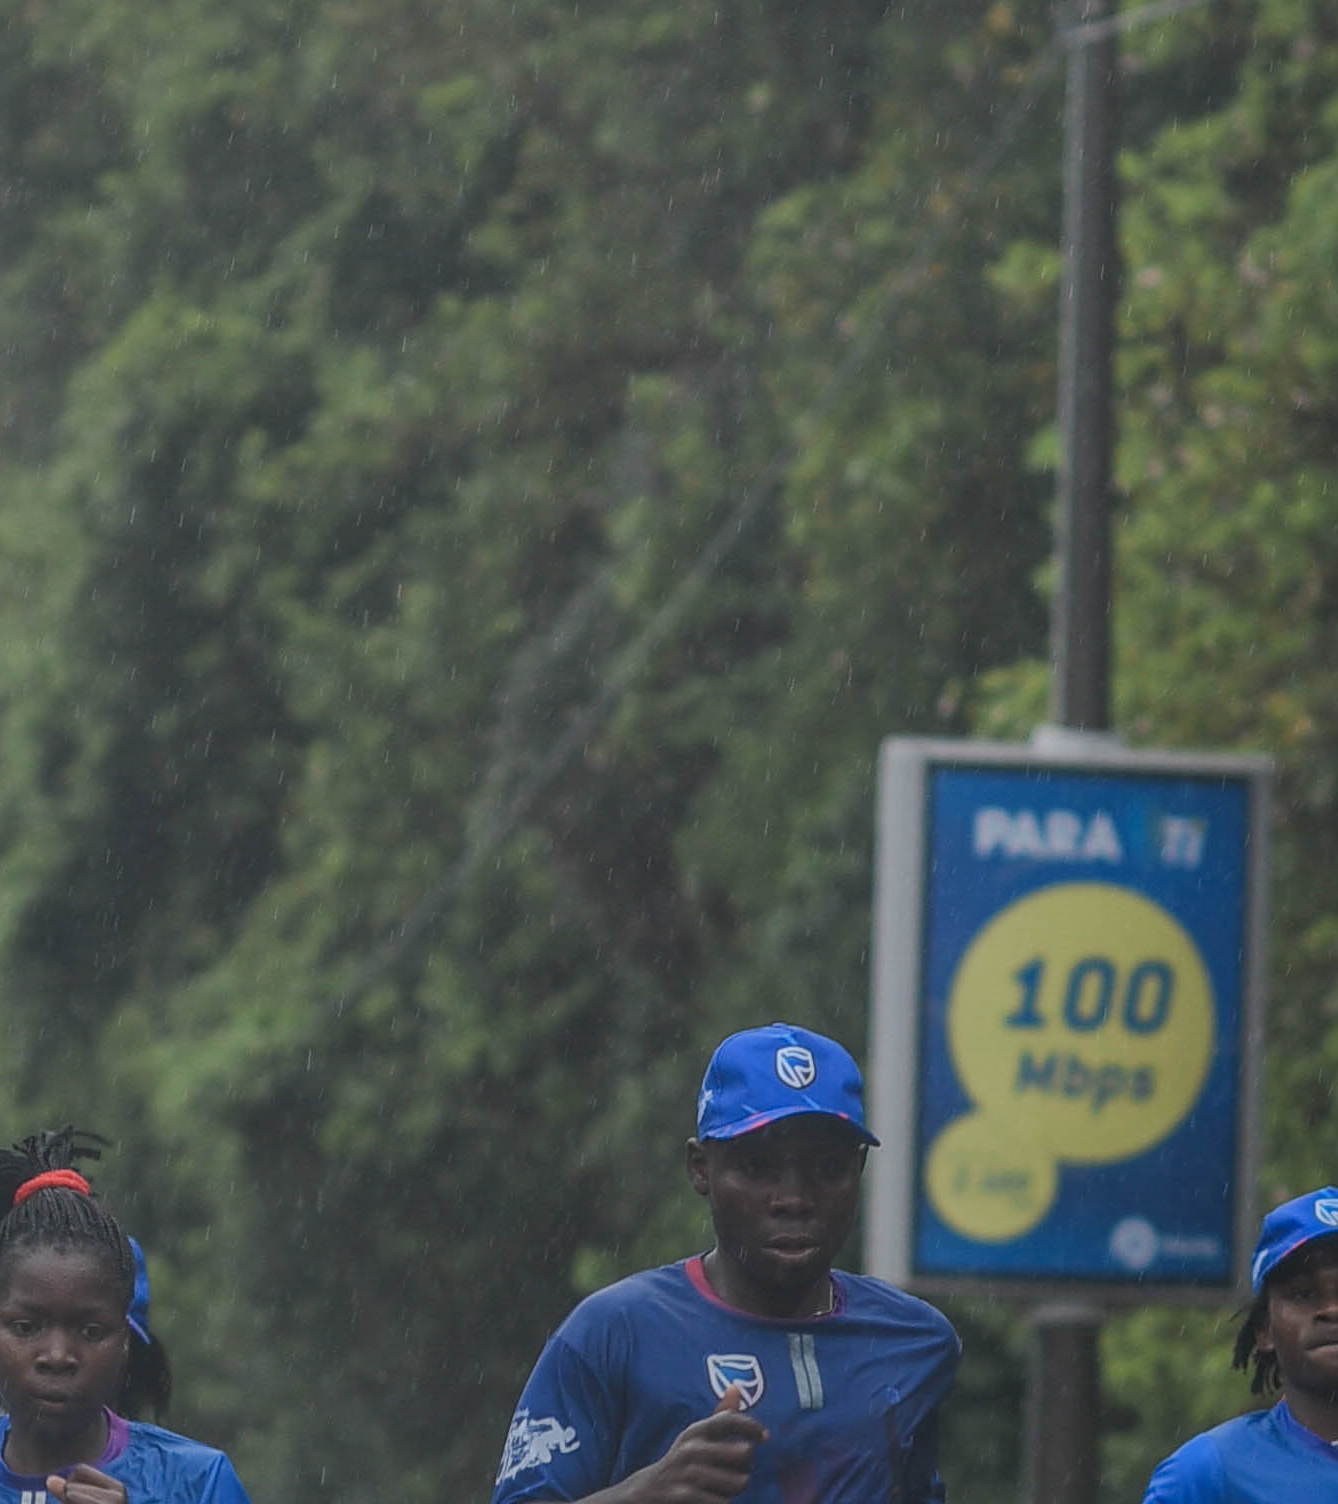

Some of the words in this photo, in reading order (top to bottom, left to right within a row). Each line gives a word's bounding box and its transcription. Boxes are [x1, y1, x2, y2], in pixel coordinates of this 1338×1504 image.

[972, 807, 1122, 865] PARA
[1004, 956, 1176, 1035] 100
[1015, 1050, 1157, 1116] Mbps
